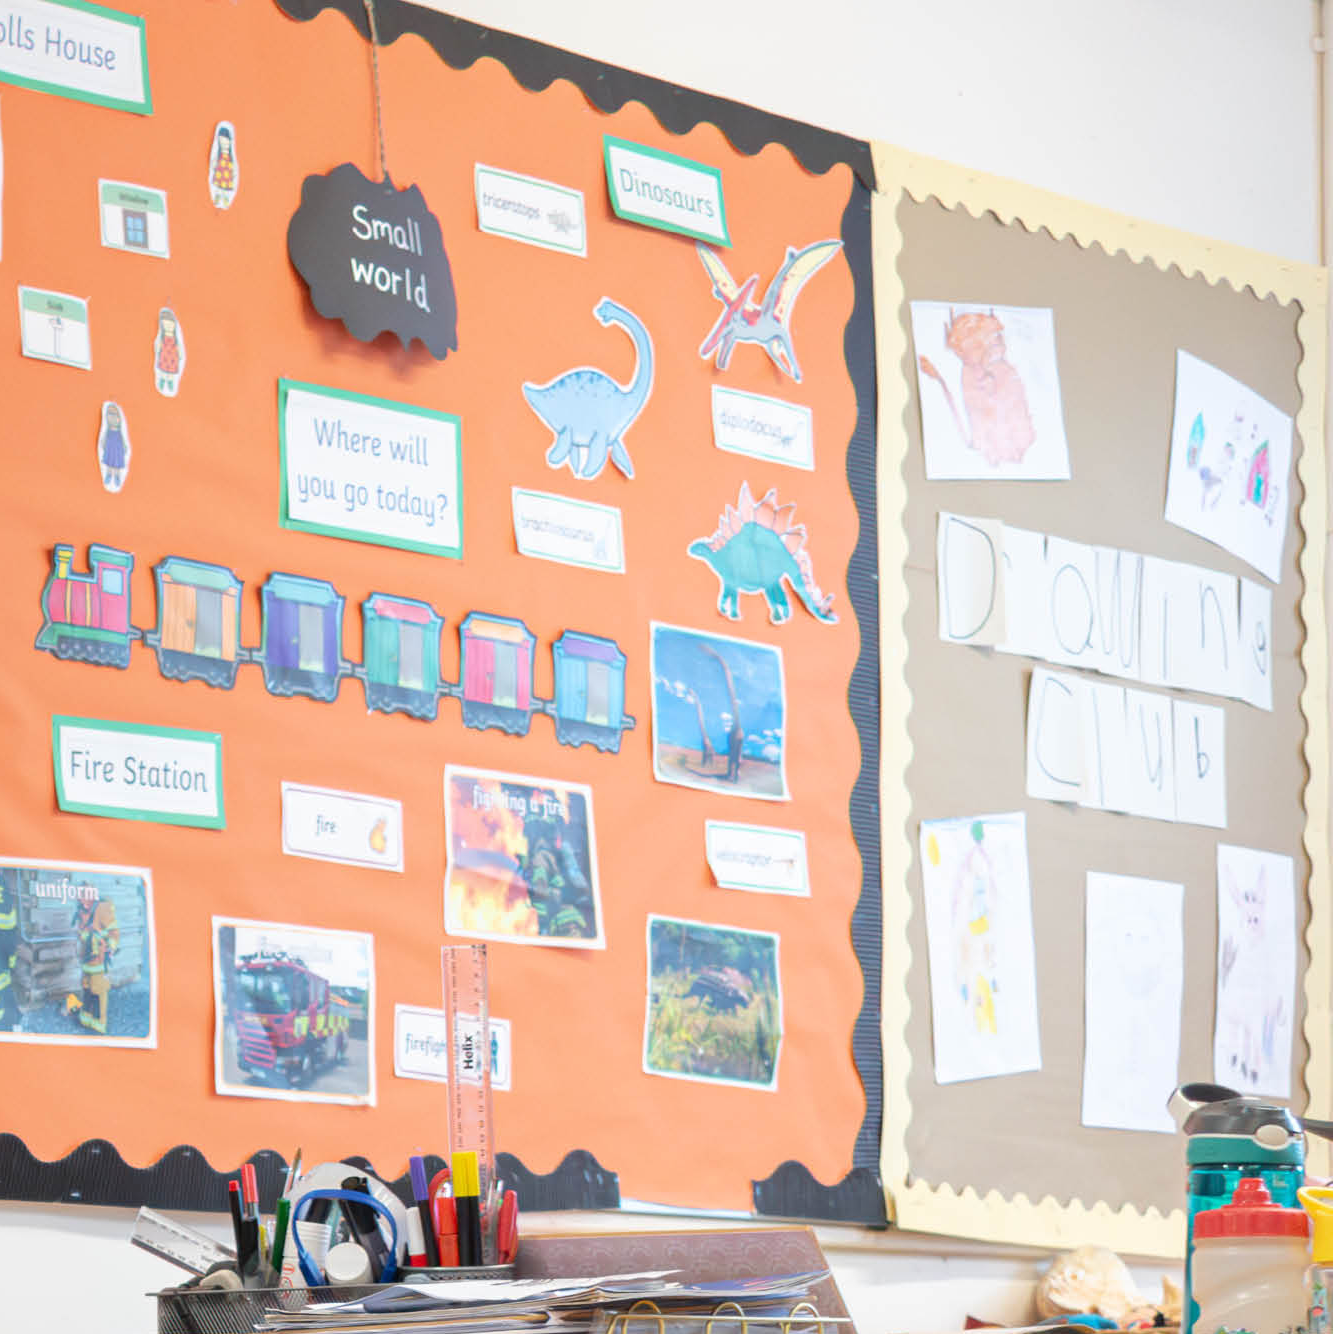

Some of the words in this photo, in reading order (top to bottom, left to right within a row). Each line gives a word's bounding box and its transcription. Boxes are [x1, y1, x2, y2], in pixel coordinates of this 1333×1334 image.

[45, 26, 117, 71] House
[619, 168, 716, 219] Dinosaurs
[351, 204, 423, 257] Small
[351, 256, 431, 313] world
[313, 417, 383, 458] Where
[389, 434, 429, 467] will
[297, 473, 337, 504] you
[344, 483, 370, 514] go
[376, 485, 448, 528] today?
[70, 750, 114, 784] Fire
[123, 754, 209, 794] Station
[315, 815, 338, 838] fire
[36, 879, 99, 904] uniform
[463, 1035, 474, 1070] Helix
